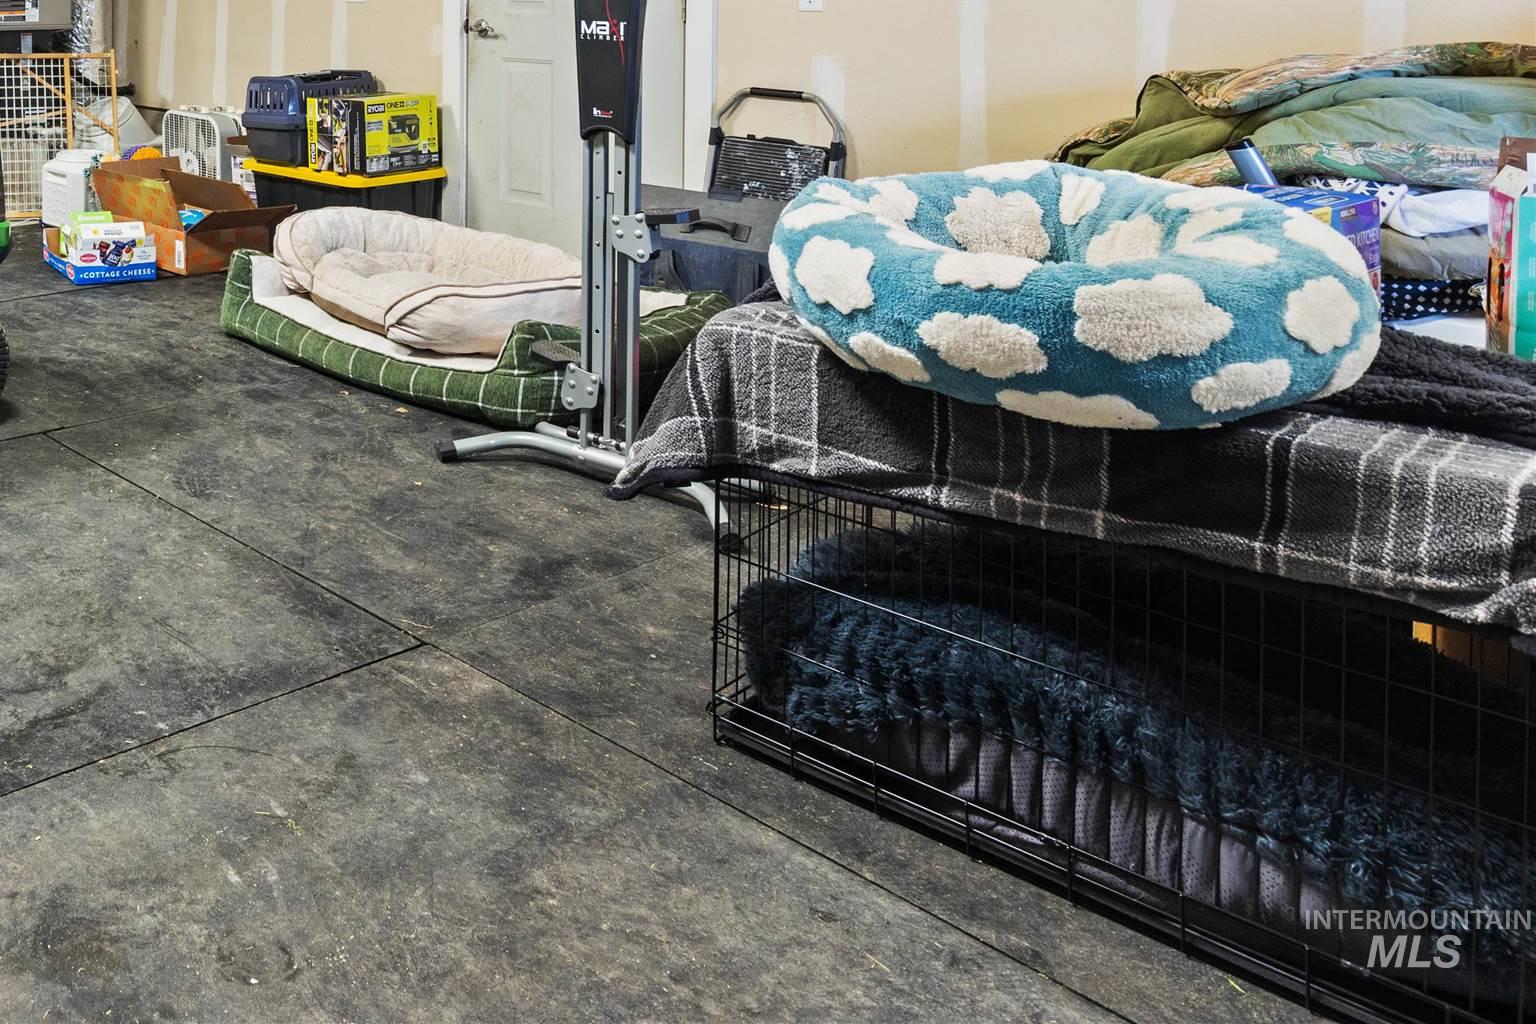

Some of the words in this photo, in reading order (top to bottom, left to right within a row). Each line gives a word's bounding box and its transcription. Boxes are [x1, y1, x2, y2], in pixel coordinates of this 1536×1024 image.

[367, 104, 384, 113] RYOBI
[83, 271, 120, 279] COTTAGE
[122, 268, 151, 276] CHEESE
